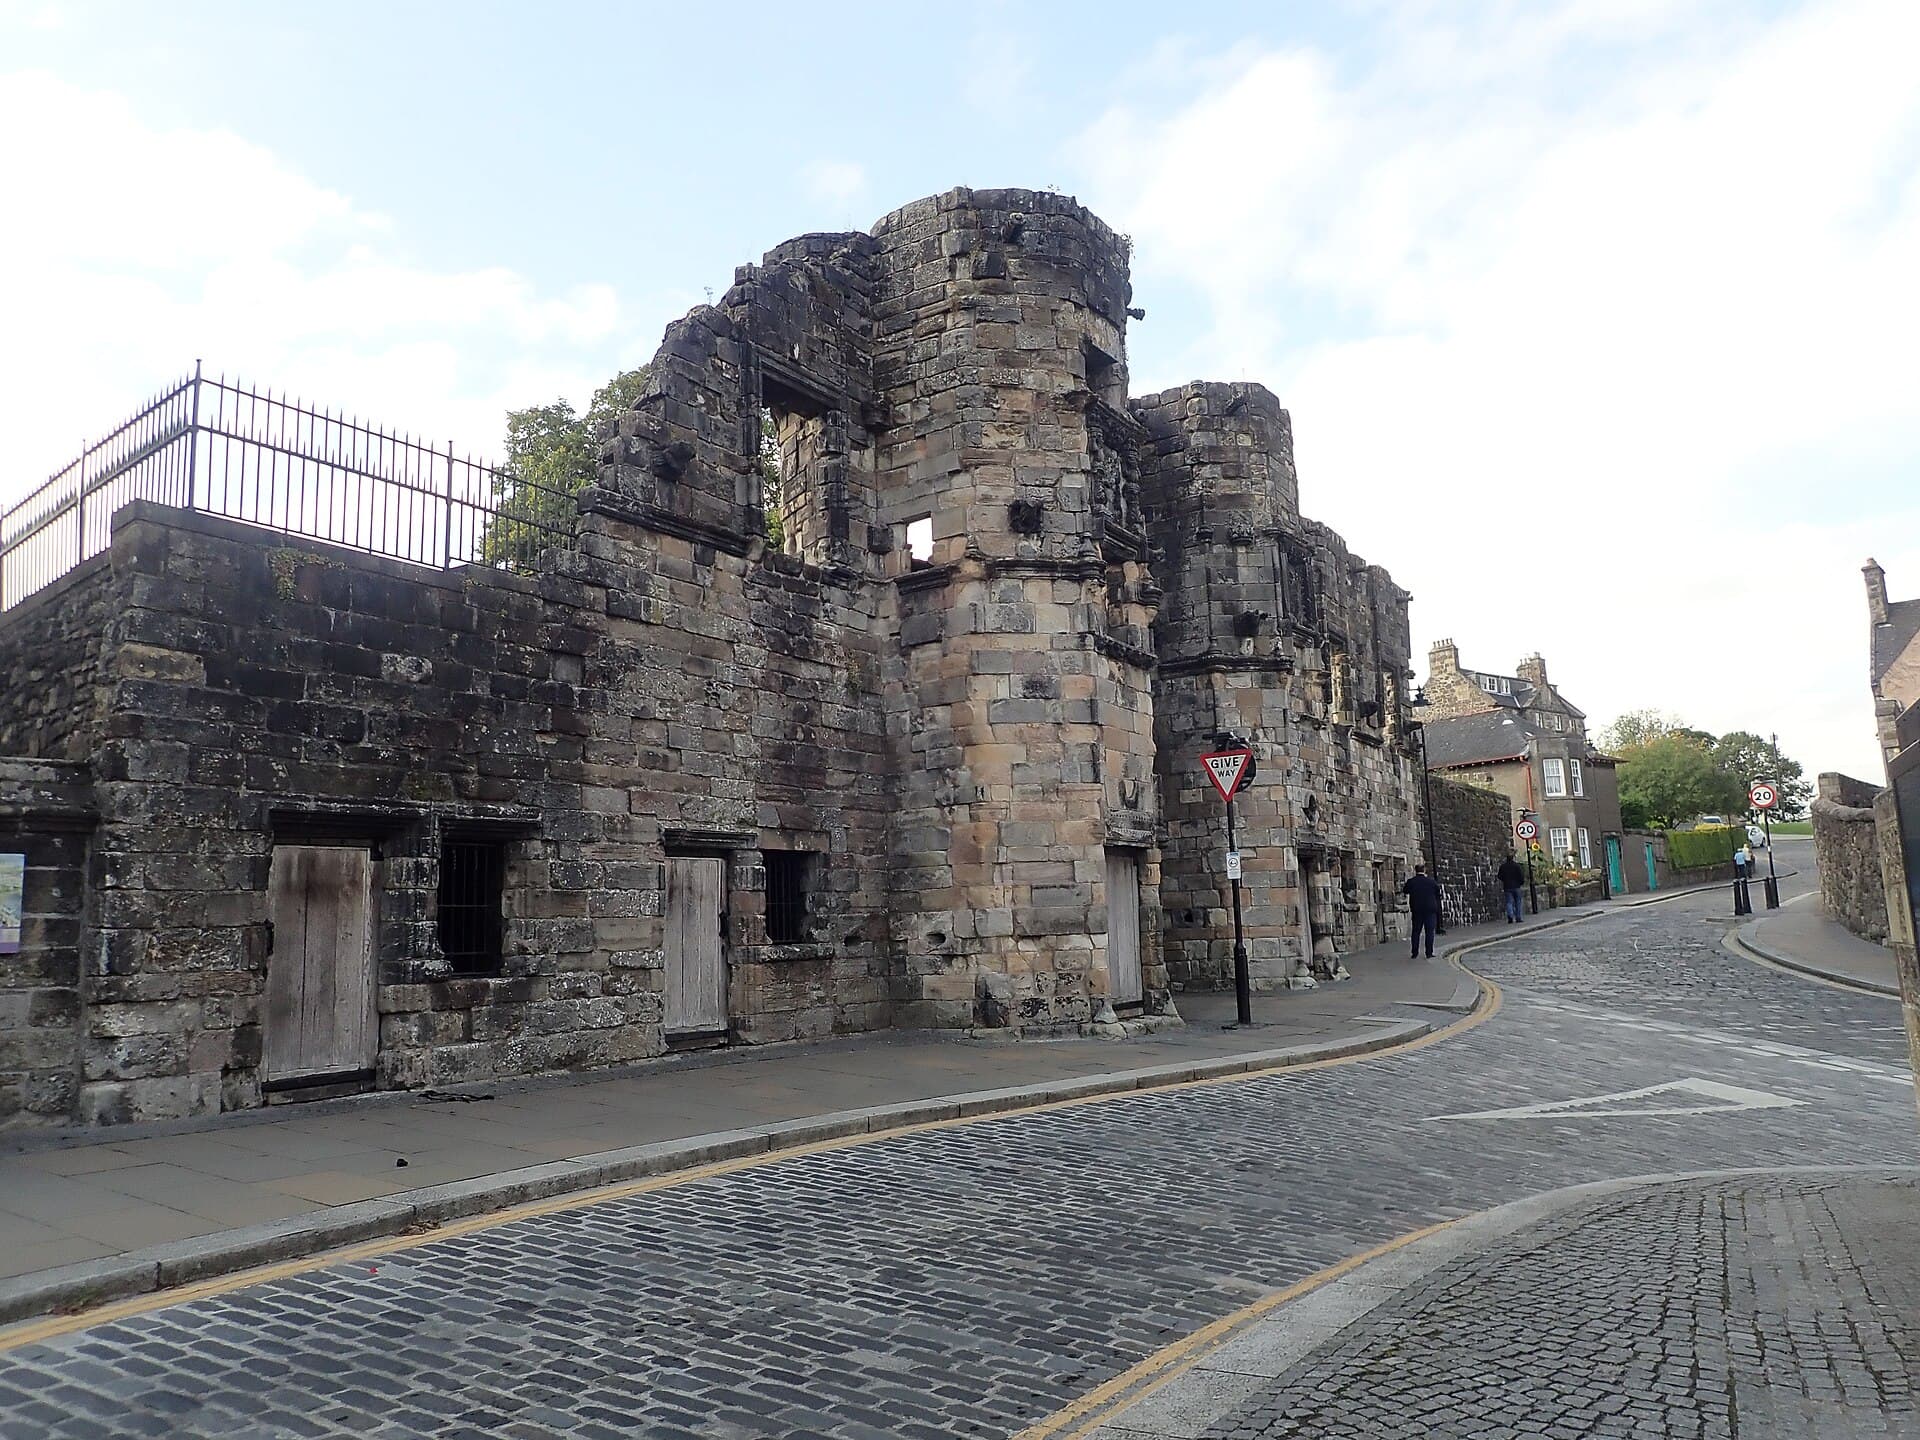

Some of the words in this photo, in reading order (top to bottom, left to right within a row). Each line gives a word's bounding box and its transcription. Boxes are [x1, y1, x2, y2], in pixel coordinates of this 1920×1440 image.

[1211, 757, 1239, 768] GIVE
[1754, 792, 1770, 800] 20
[1519, 825, 1534, 834] 20
